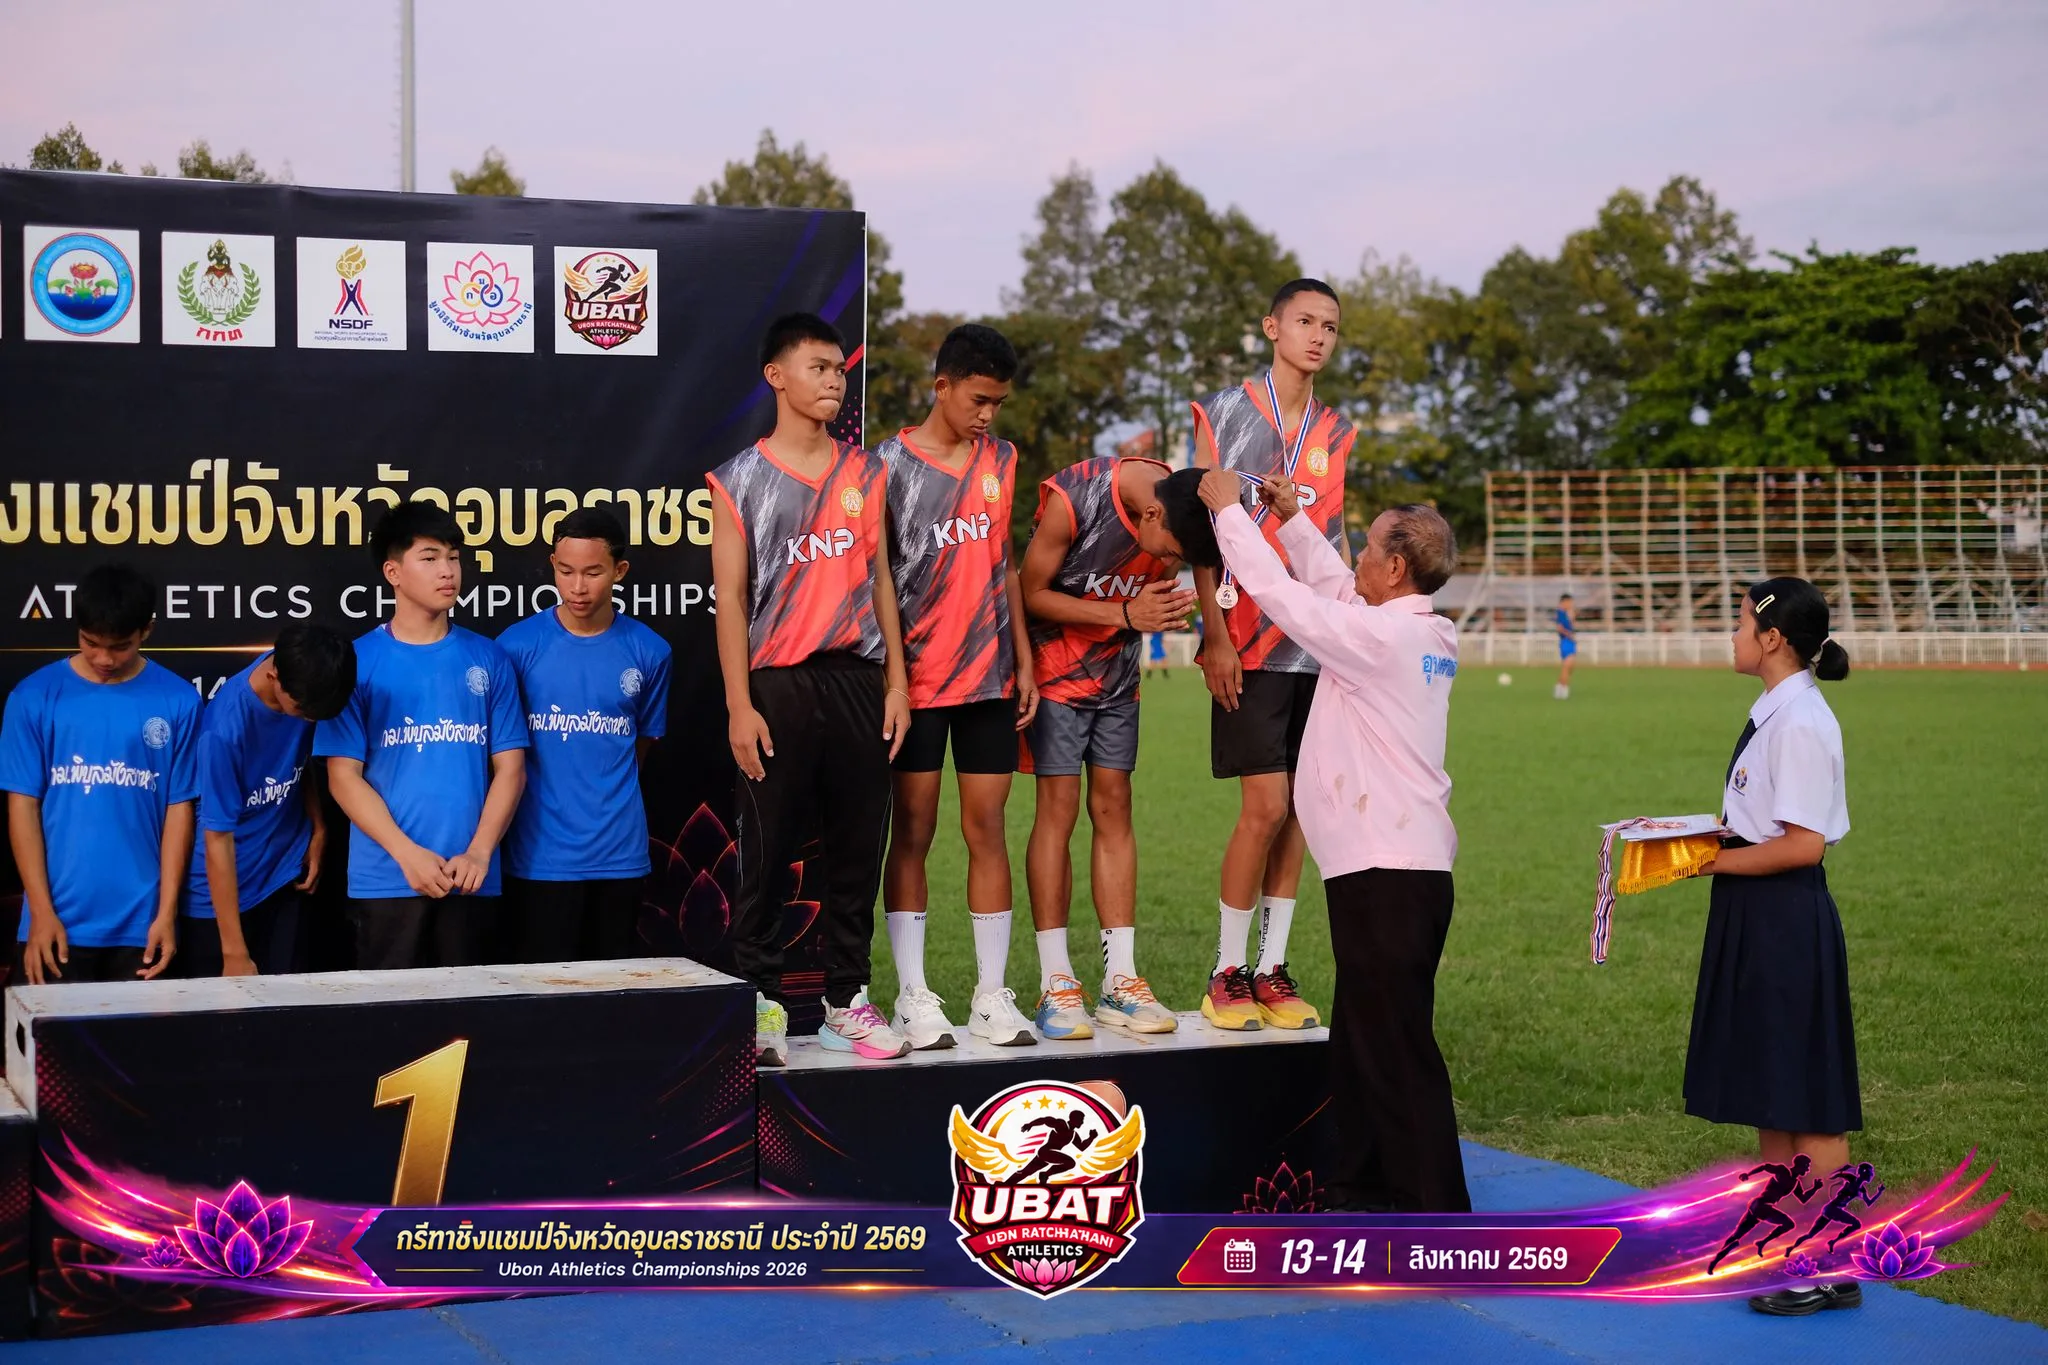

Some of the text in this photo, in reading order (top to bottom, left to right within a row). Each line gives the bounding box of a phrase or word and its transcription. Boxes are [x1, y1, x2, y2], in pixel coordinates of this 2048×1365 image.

[329, 318, 374, 330] NSDF
[571, 301, 642, 322] UBAT
[577, 322, 596, 330] UBON
[786, 528, 856, 566] KNP
[932, 512, 992, 549] KNP
[20, 585, 313, 620] ATETICS
[373, 1039, 469, 1207] 1
